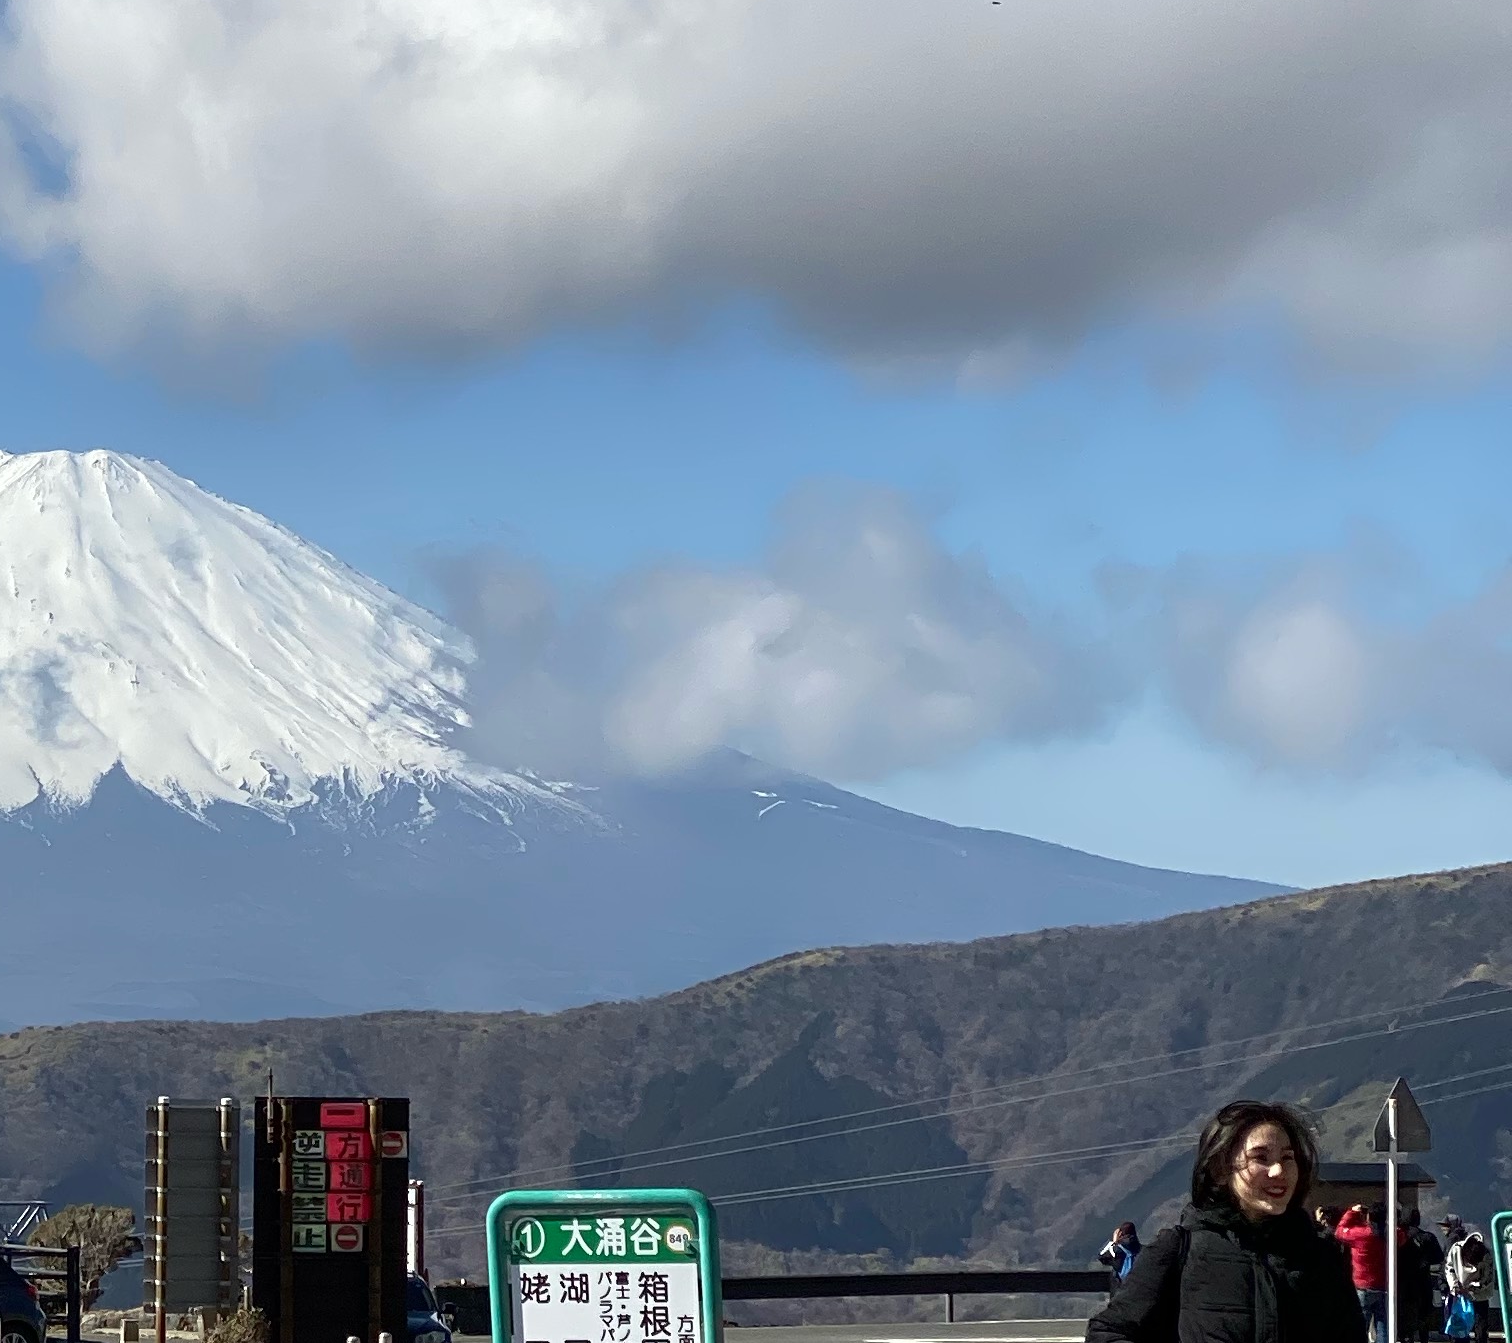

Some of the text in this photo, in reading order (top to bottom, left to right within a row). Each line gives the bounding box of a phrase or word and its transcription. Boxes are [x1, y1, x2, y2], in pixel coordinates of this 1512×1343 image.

[292, 1132, 325, 1247] 逆走禁止
[327, 1108, 362, 1221] 一方通行
[560, 1217, 662, 1257] 大涌谷
